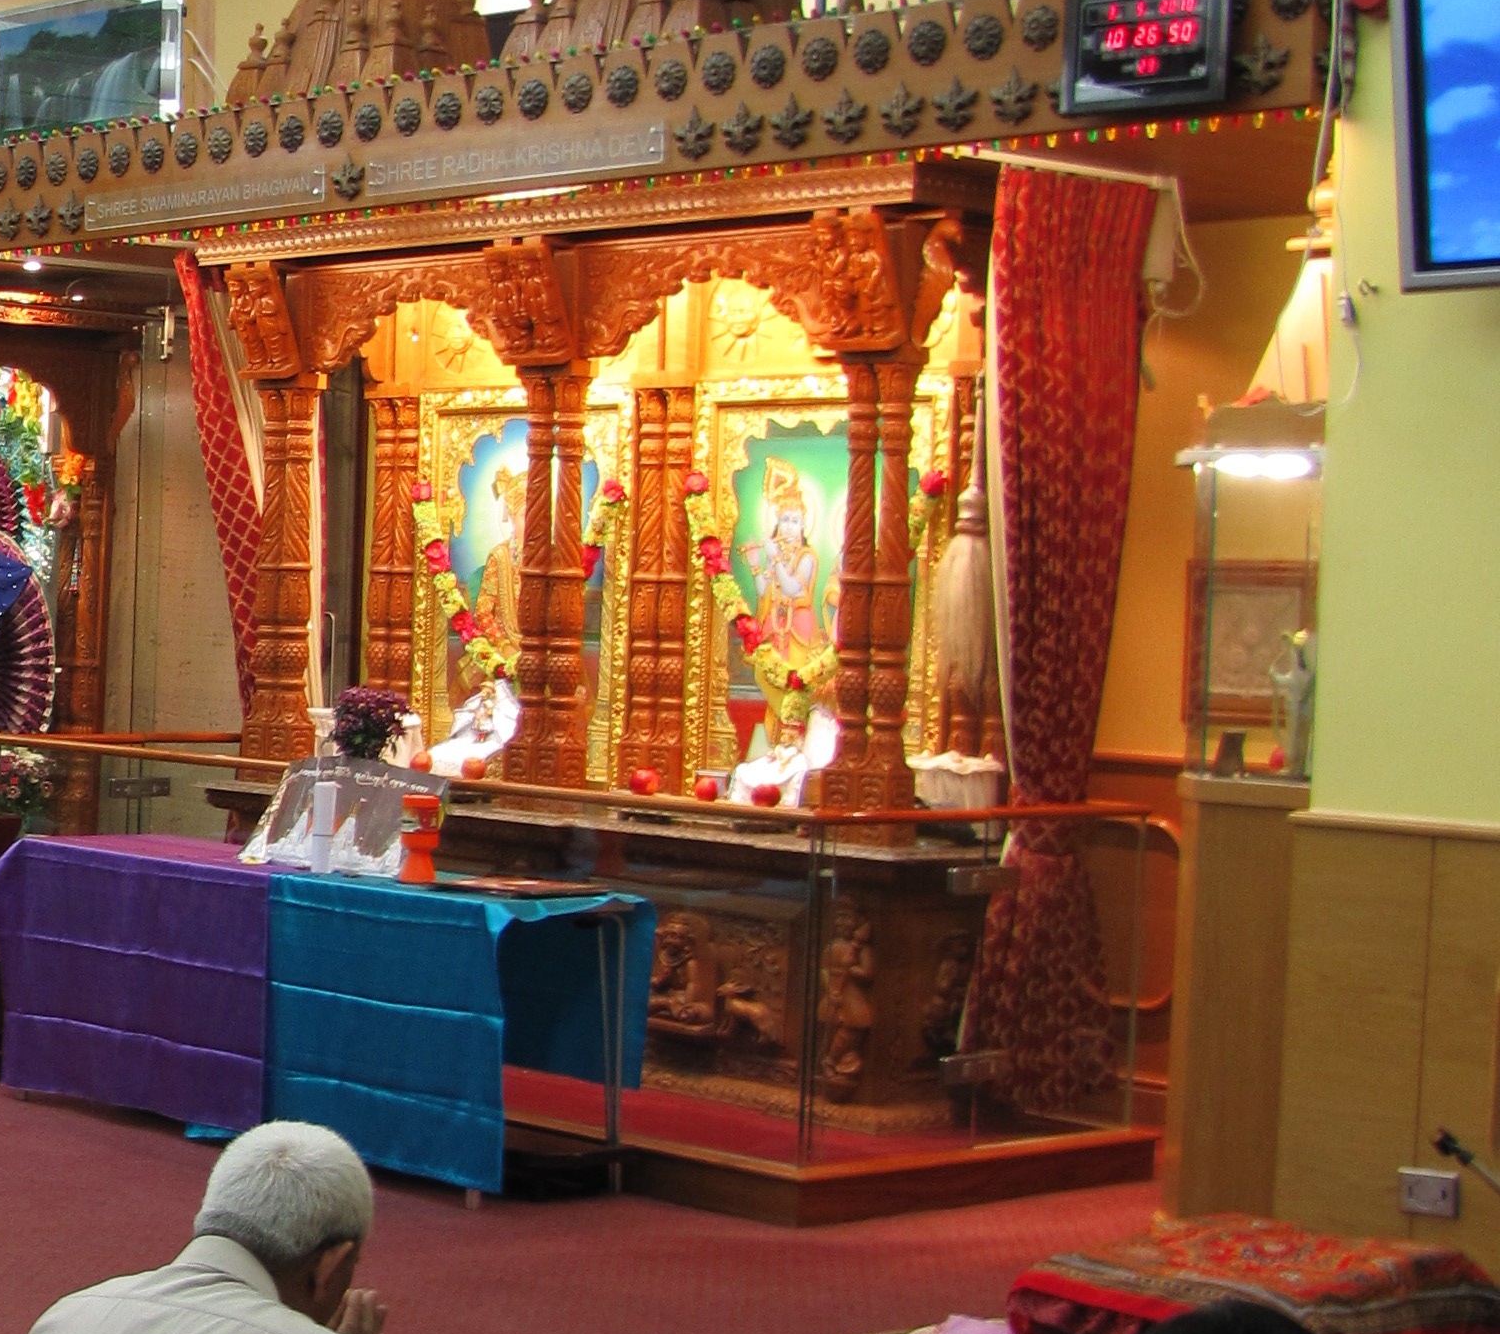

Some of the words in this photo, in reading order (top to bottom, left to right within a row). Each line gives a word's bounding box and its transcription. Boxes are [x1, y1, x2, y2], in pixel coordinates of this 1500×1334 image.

[1132, 21, 1163, 48] 26
[1168, 18, 1198, 45] 50
[374, 157, 437, 185] SHREE
[442, 136, 602, 178] RADHA-KRISHNA
[97, 198, 138, 218] SHREE
[140, 185, 239, 213] SWAMINARAYAN
[242, 177, 311, 200] BHAGWAN
